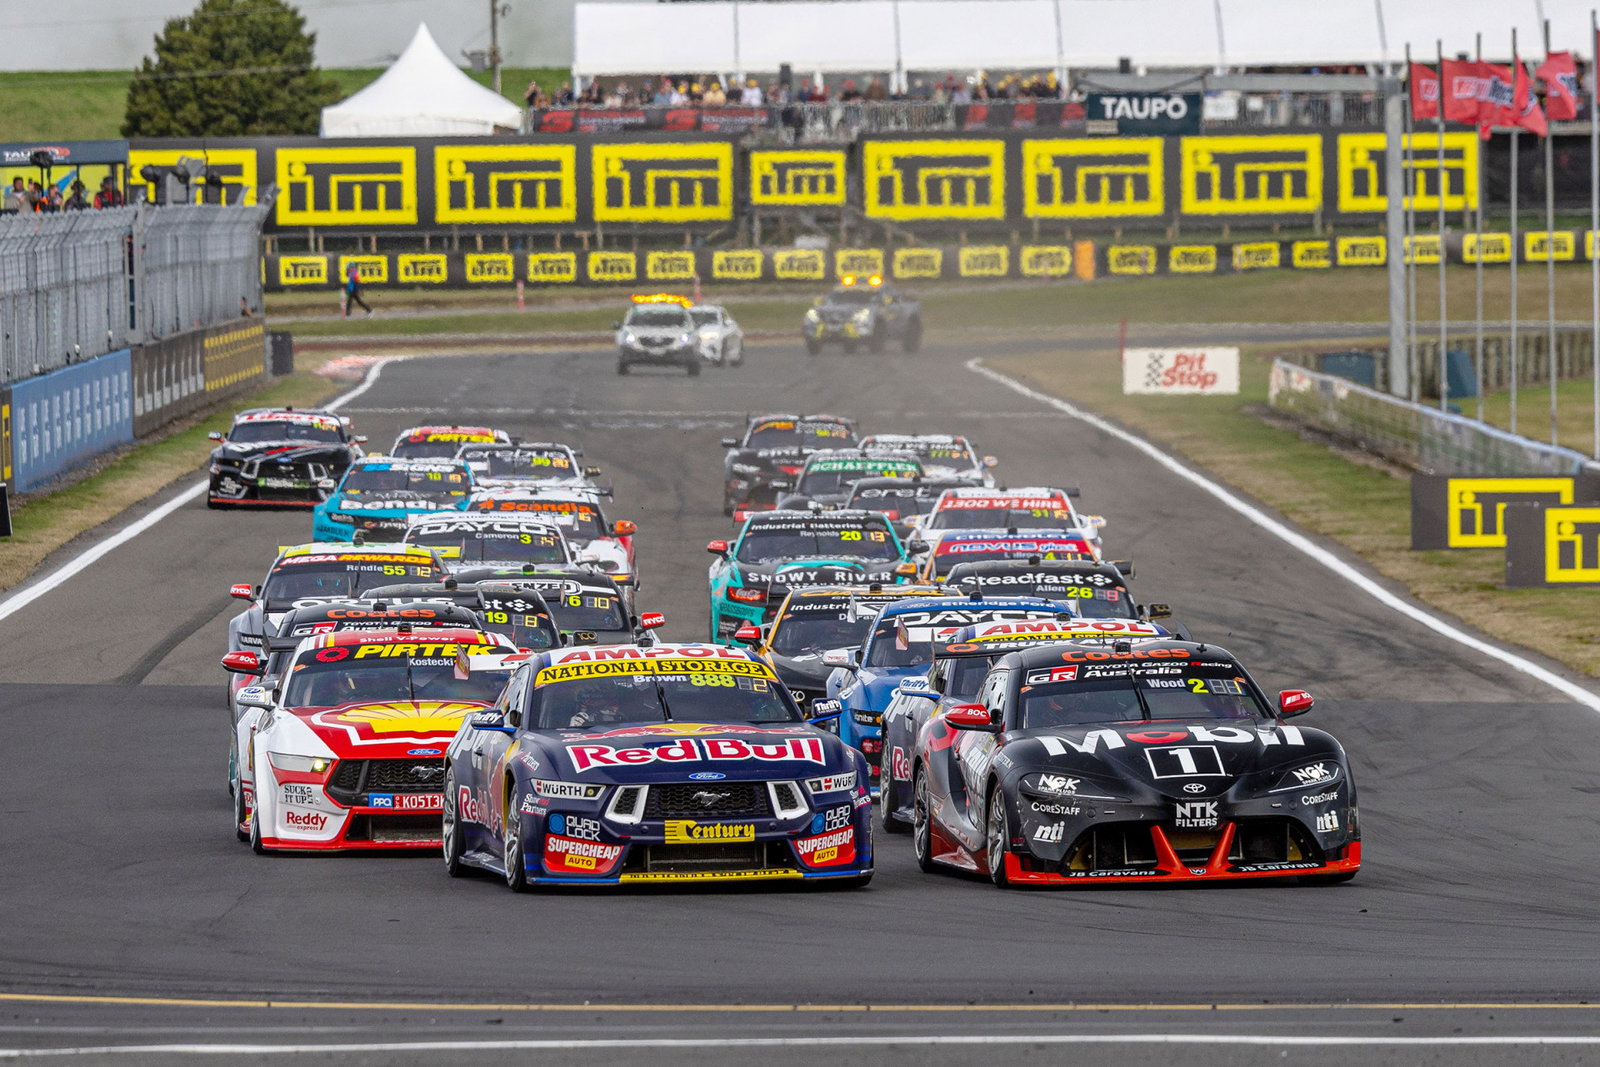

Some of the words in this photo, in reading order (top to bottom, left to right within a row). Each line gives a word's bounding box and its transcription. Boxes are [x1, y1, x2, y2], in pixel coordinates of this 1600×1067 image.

[1174, 353, 1206, 372] Pit
[1161, 369, 1218, 390] Stop
[1032, 508, 1049, 518] 31
[418, 520, 549, 535] DAYCO
[751, 523, 806, 531] Industrial
[475, 532, 520, 540] Cameron
[519, 533, 532, 544] 3
[840, 530, 862, 541] 20
[280, 554, 338, 566] MEGA
[338, 553, 434, 565] REWARDS
[382, 565, 406, 576] 55
[748, 571, 818, 583] SNOWY
[834, 571, 892, 582] RIVER
[960, 572, 1084, 587] Steadfast
[1035, 585, 1066, 594] Allen
[1066, 585, 1094, 599] 26
[568, 595, 582, 607] 6
[327, 608, 437, 619] Coates
[484, 611, 509, 624] 19
[294, 624, 335, 637] GR
[433, 621, 471, 629] Racing
[982, 620, 1154, 636] AMPOL
[359, 635, 393, 643] Shell
[353, 643, 498, 660] PIRTEK
[556, 646, 745, 664] AMPOL
[1061, 647, 1192, 662] Coates
[239, 655, 256, 664] BOC
[409, 657, 454, 667] Kostecki
[1084, 662, 1139, 670] TOYOTA
[1190, 661, 1233, 669] Racing
[542, 661, 653, 682] NATIONAL
[660, 660, 764, 675] STORAGE
[1028, 667, 1077, 684] GR
[1084, 667, 1183, 679] Australia
[632, 674, 688, 683] Brown
[690, 673, 736, 688] 888
[901, 679, 929, 690] Thrifty
[1146, 679, 1186, 689] Wood
[1187, 678, 1210, 694] 2
[967, 708, 987, 718] BOC
[1034, 725, 1306, 757] Mobil
[565, 738, 702, 774] Red
[701, 737, 827, 767] Bull
[1168, 748, 1199, 774] 1
[1291, 762, 1331, 781] NGK
[1038, 773, 1081, 790] NGK
[284, 785, 307, 795] SUCK
[285, 794, 294, 803] IT
[295, 796, 307, 804] UP
[373, 797, 392, 807] PPQ
[825, 805, 851, 821] QUAD
[1175, 800, 1218, 819] NTK
[286, 811, 328, 831] Reddy
[566, 815, 601, 832] QUAD
[825, 815, 850, 832] LOCK
[1175, 817, 1218, 828] FILTERS
[1316, 810, 1339, 832] nti
[566, 826, 601, 842] LOCK
[672, 820, 755, 843] Century
[1033, 820, 1066, 842] nti
[547, 837, 621, 861] SUPERCHEAP
[797, 828, 854, 856] SUPERCHEAP
[567, 856, 593, 867] AUTO
[816, 849, 836, 860] AUTO
[1237, 865, 1257, 873] JB
[1260, 860, 1320, 872] Caravans
[1089, 870, 1156, 878] Caravans
